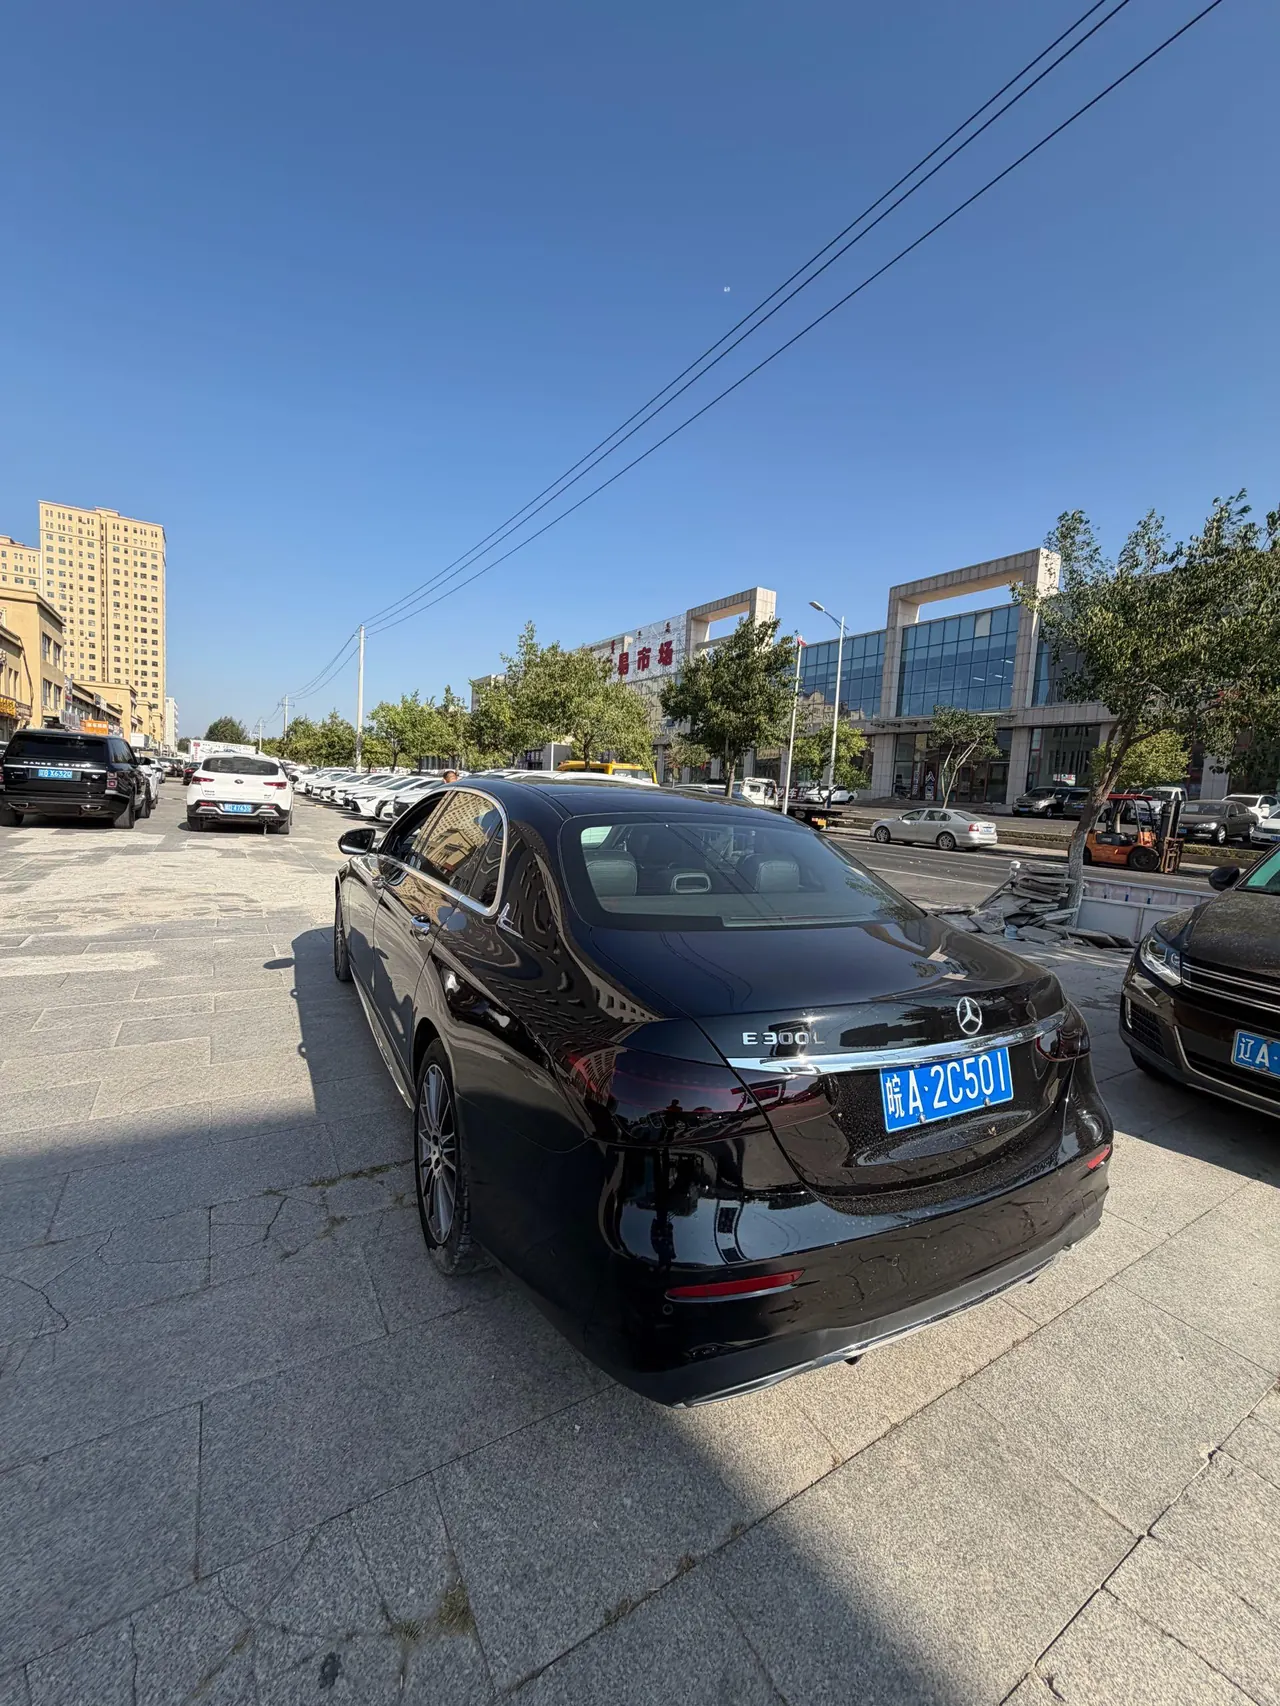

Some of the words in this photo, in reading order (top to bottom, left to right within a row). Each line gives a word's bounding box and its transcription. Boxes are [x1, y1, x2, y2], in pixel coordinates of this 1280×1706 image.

[608, 640, 674, 676] 易市场
[885, 1051, 1006, 1119] 皖A·2C501
